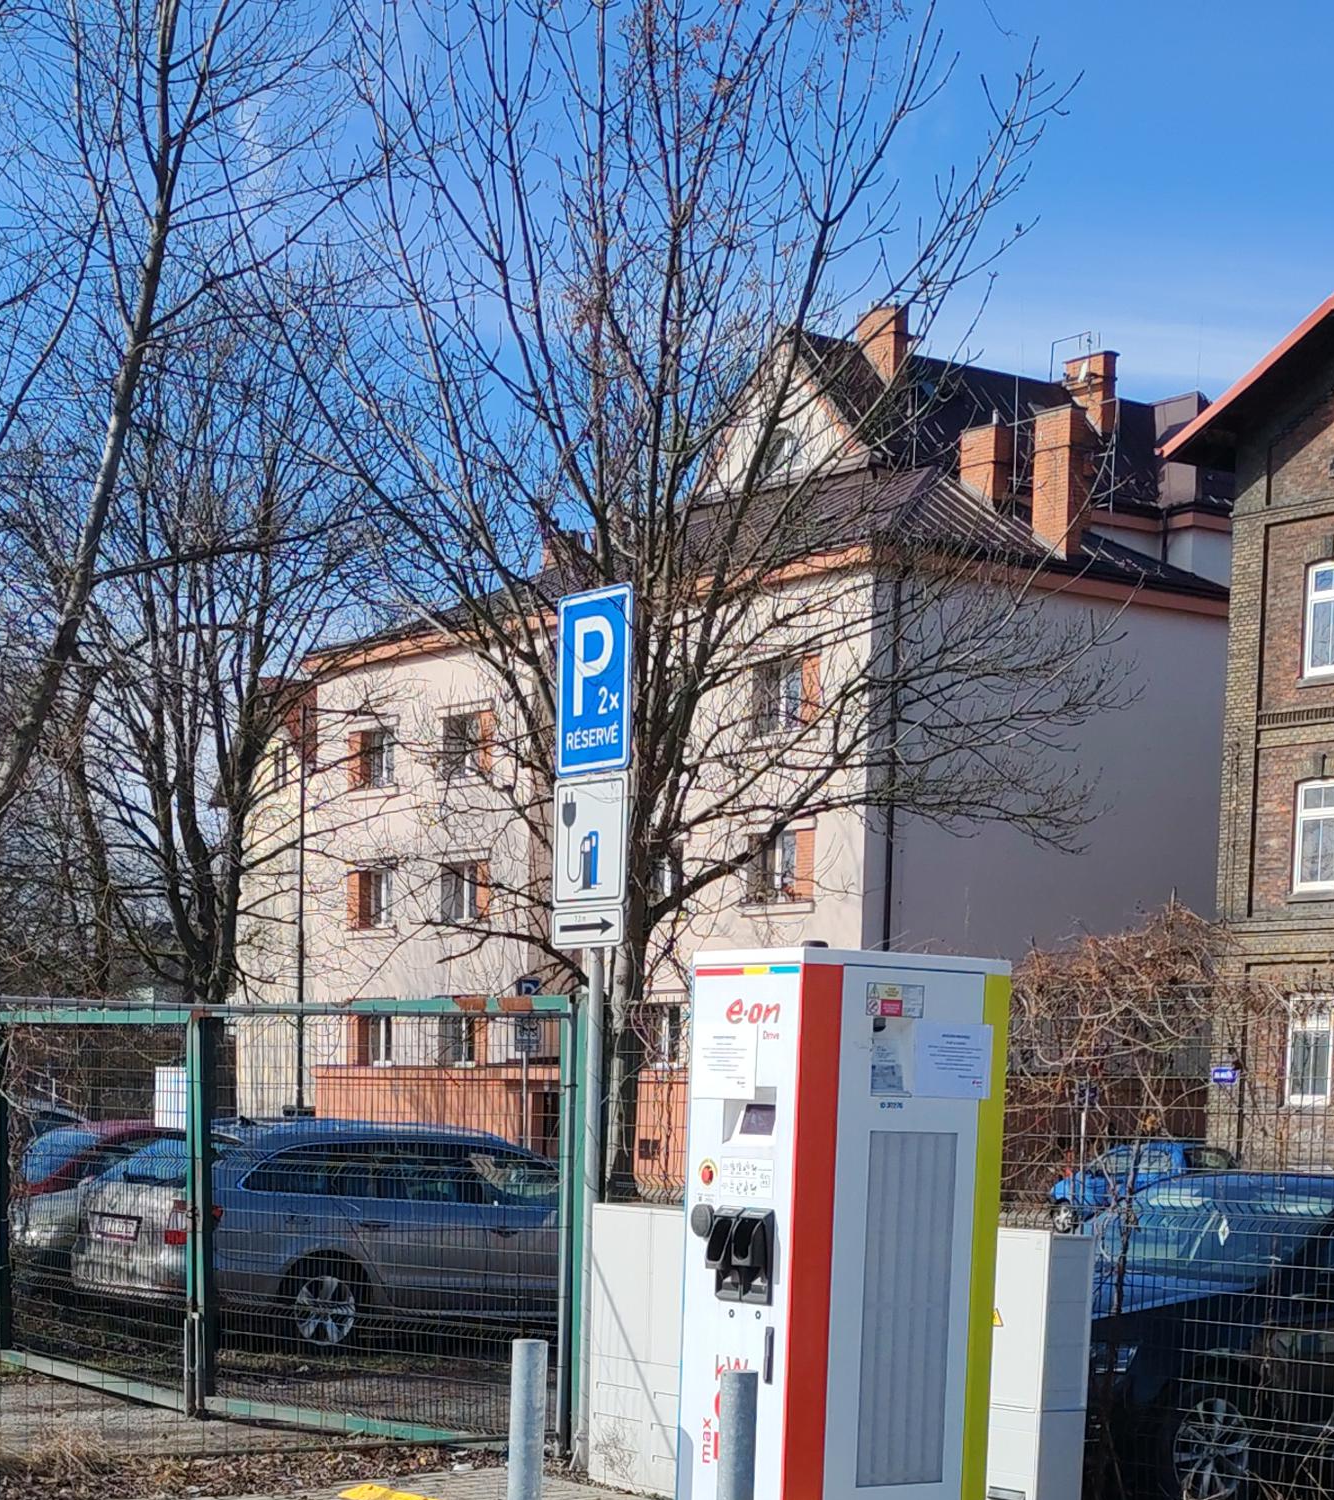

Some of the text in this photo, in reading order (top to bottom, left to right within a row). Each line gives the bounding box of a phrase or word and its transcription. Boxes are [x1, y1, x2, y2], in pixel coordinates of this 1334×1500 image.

[573, 615, 614, 717] P
[597, 685, 620, 715] 2x
[565, 720, 620, 752] RÉSERVÉ
[702, 1417, 712, 1463] max
